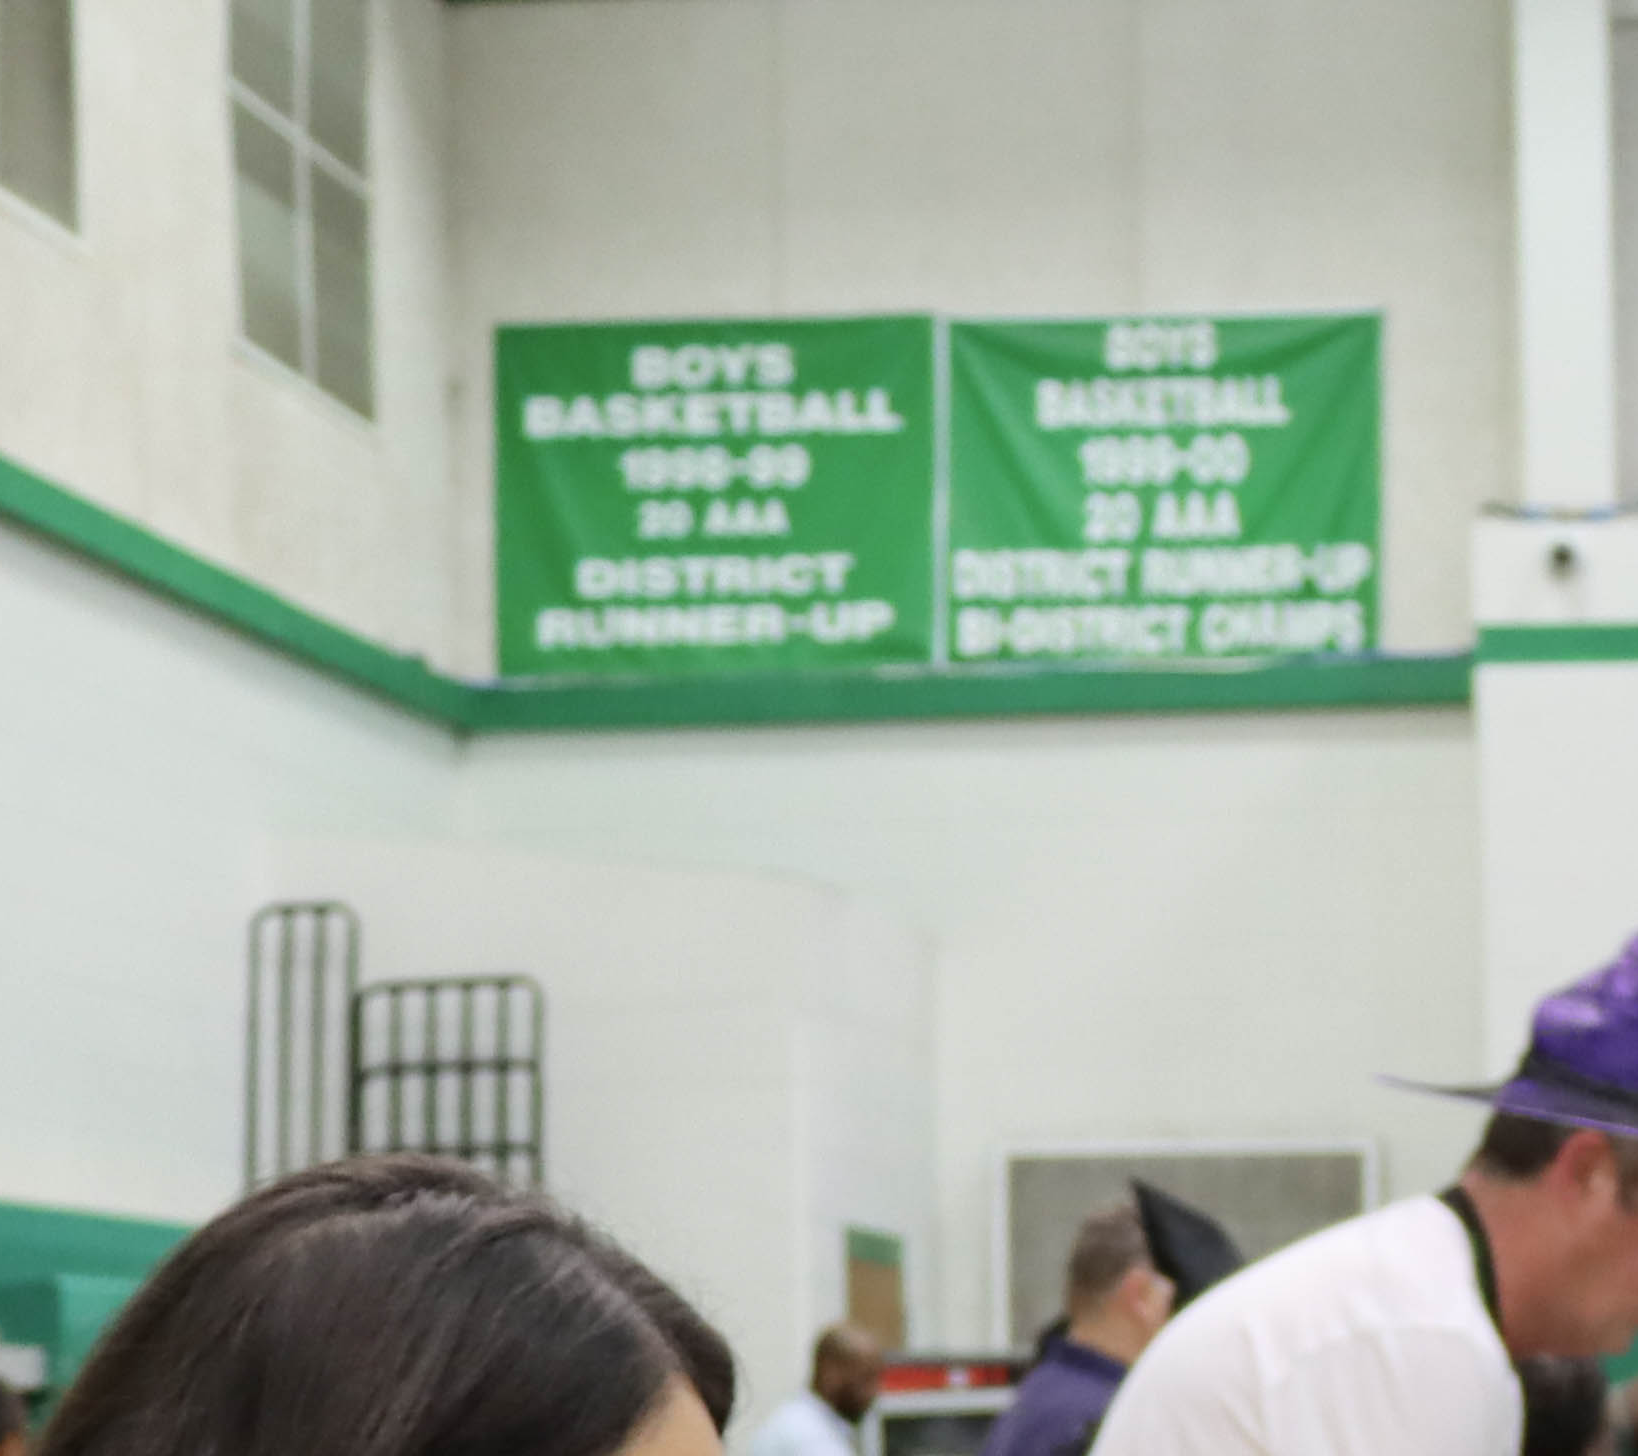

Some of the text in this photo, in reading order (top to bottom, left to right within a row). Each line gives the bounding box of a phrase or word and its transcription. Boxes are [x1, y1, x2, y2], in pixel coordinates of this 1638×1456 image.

[631, 344, 795, 389] BOYS
[1104, 321, 1219, 370] BOYS
[522, 390, 905, 440] BASKETBALL
[1035, 377, 1291, 431] BASKETBALL
[703, 500, 790, 537] AAA
[1152, 491, 1241, 540] AAA
[574, 551, 854, 598] DISTRICT
[953, 543, 1372, 599] DISTRICT RUNNER-UP
[535, 600, 896, 650] RUNNER-UP
[958, 599, 1362, 656] BI-DISTRICT CHAMPS
